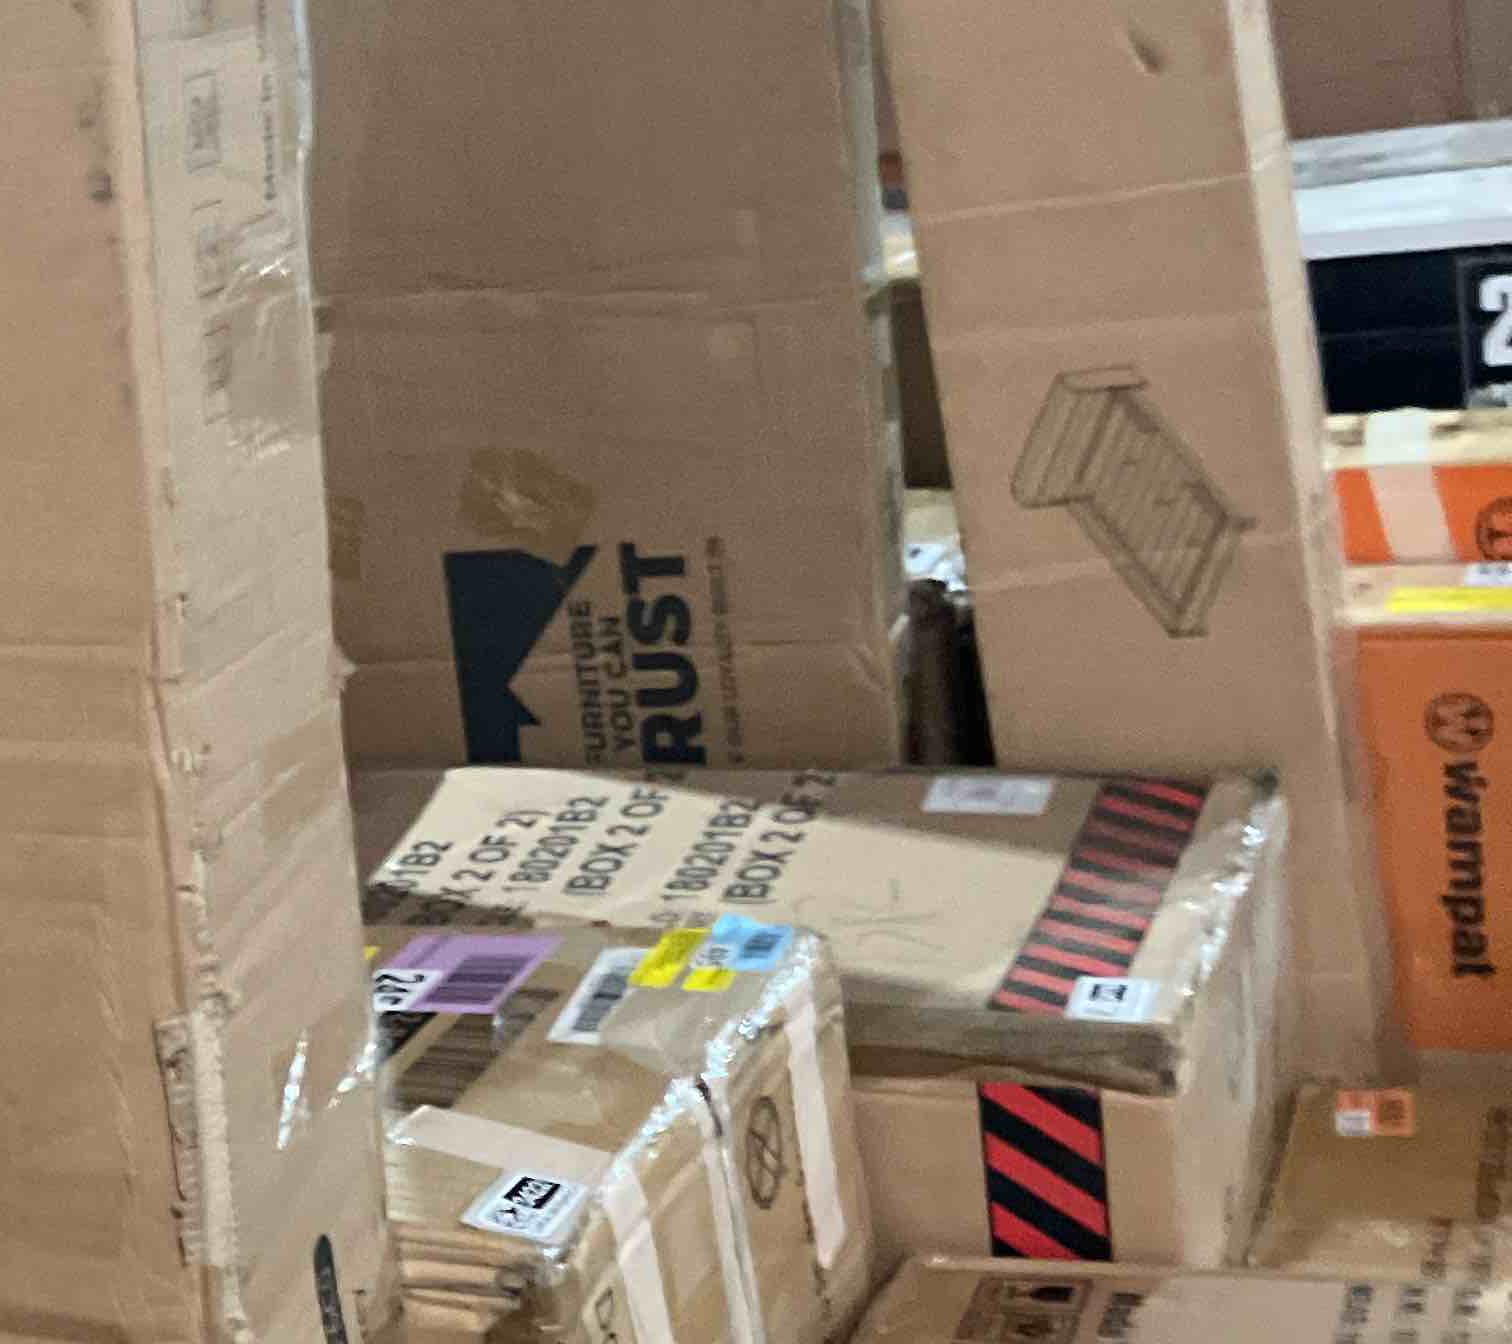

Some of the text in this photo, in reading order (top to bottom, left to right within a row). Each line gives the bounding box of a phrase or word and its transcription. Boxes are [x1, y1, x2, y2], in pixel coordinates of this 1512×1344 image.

[598, 614, 636, 751] YOU CAN
[618, 541, 708, 767] RUST
[619, 787, 670, 819] OF
